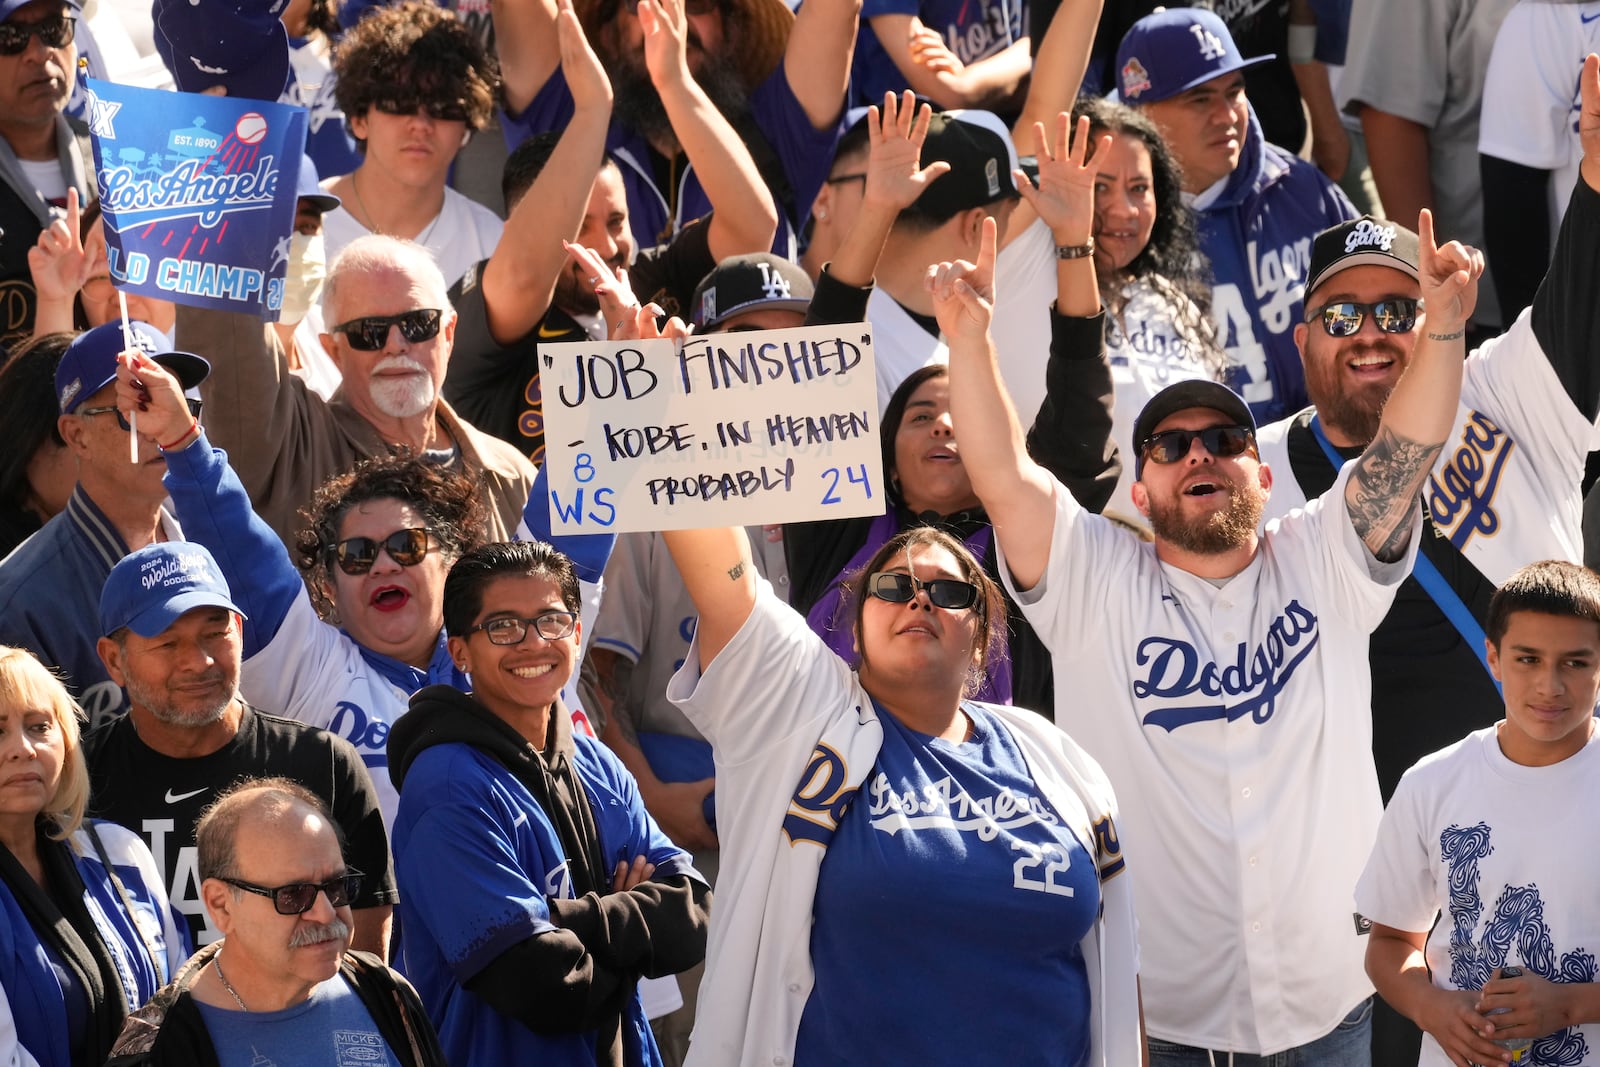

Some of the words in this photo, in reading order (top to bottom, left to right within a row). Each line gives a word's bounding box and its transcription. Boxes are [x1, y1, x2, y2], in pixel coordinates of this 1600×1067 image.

[1189, 24, 1226, 61] LA
[174, 134, 193, 147] EST.
[195, 137, 217, 149] 1890
[98, 166, 151, 211] Los
[757, 263, 791, 299] LA
[716, 420, 752, 448] IN
[766, 410, 869, 447] HEAVEN
[573, 452, 596, 483] 8
[645, 457, 796, 506] PROBABLY
[820, 463, 873, 505] 24
[551, 486, 617, 527] WS
[140, 557, 163, 572] 2024
[141, 557, 180, 590] World
[1134, 599, 1321, 728] Dodgers
[919, 775, 1059, 842] Angees
[1011, 840, 1075, 898] 22
[336, 1033, 382, 1045] MICKEY
